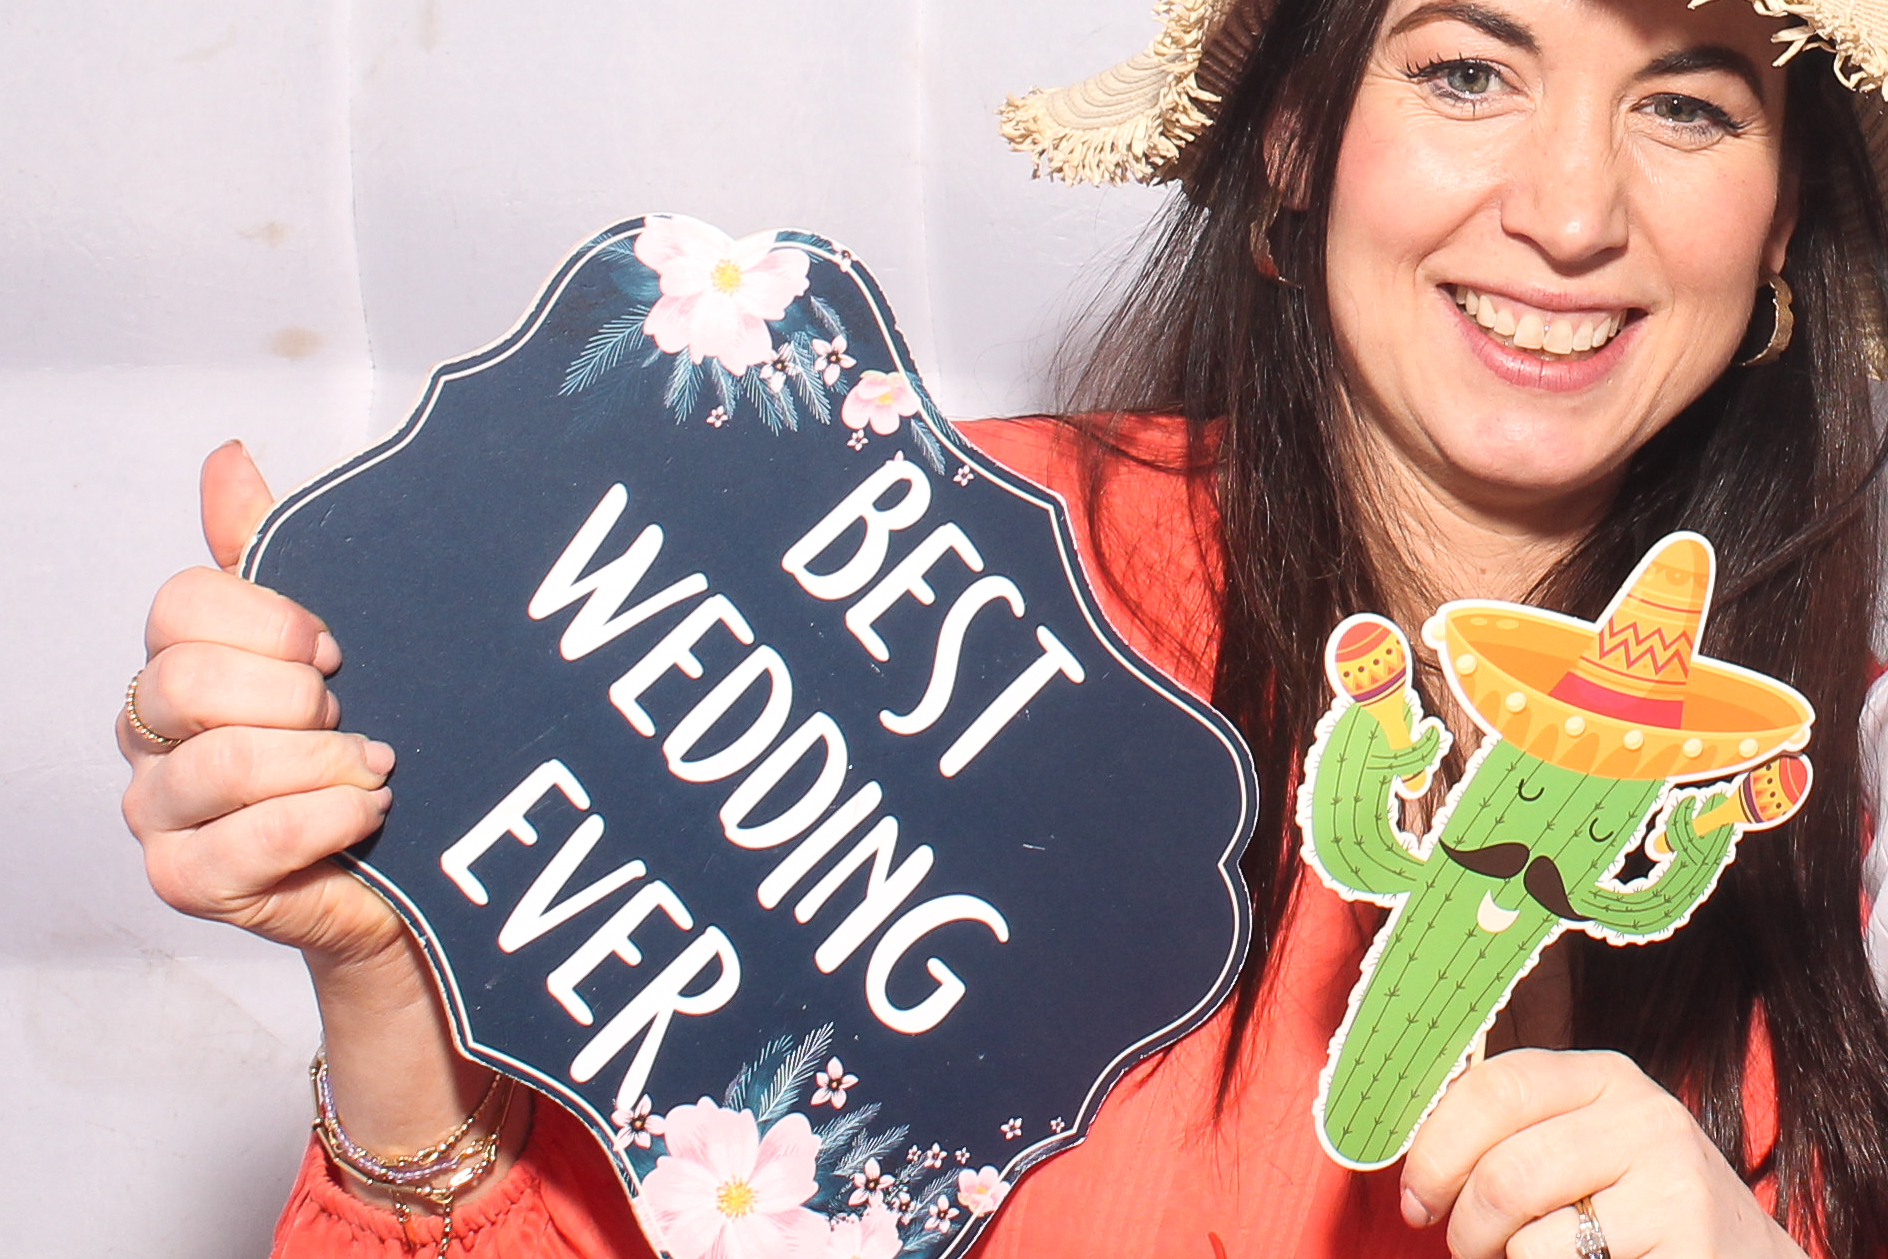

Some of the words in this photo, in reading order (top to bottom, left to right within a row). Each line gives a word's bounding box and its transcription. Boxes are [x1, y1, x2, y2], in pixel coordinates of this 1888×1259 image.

[527, 482, 1010, 1034] WEDDING
[780, 458, 1085, 777] BEST
[439, 758, 742, 1110] EVER
